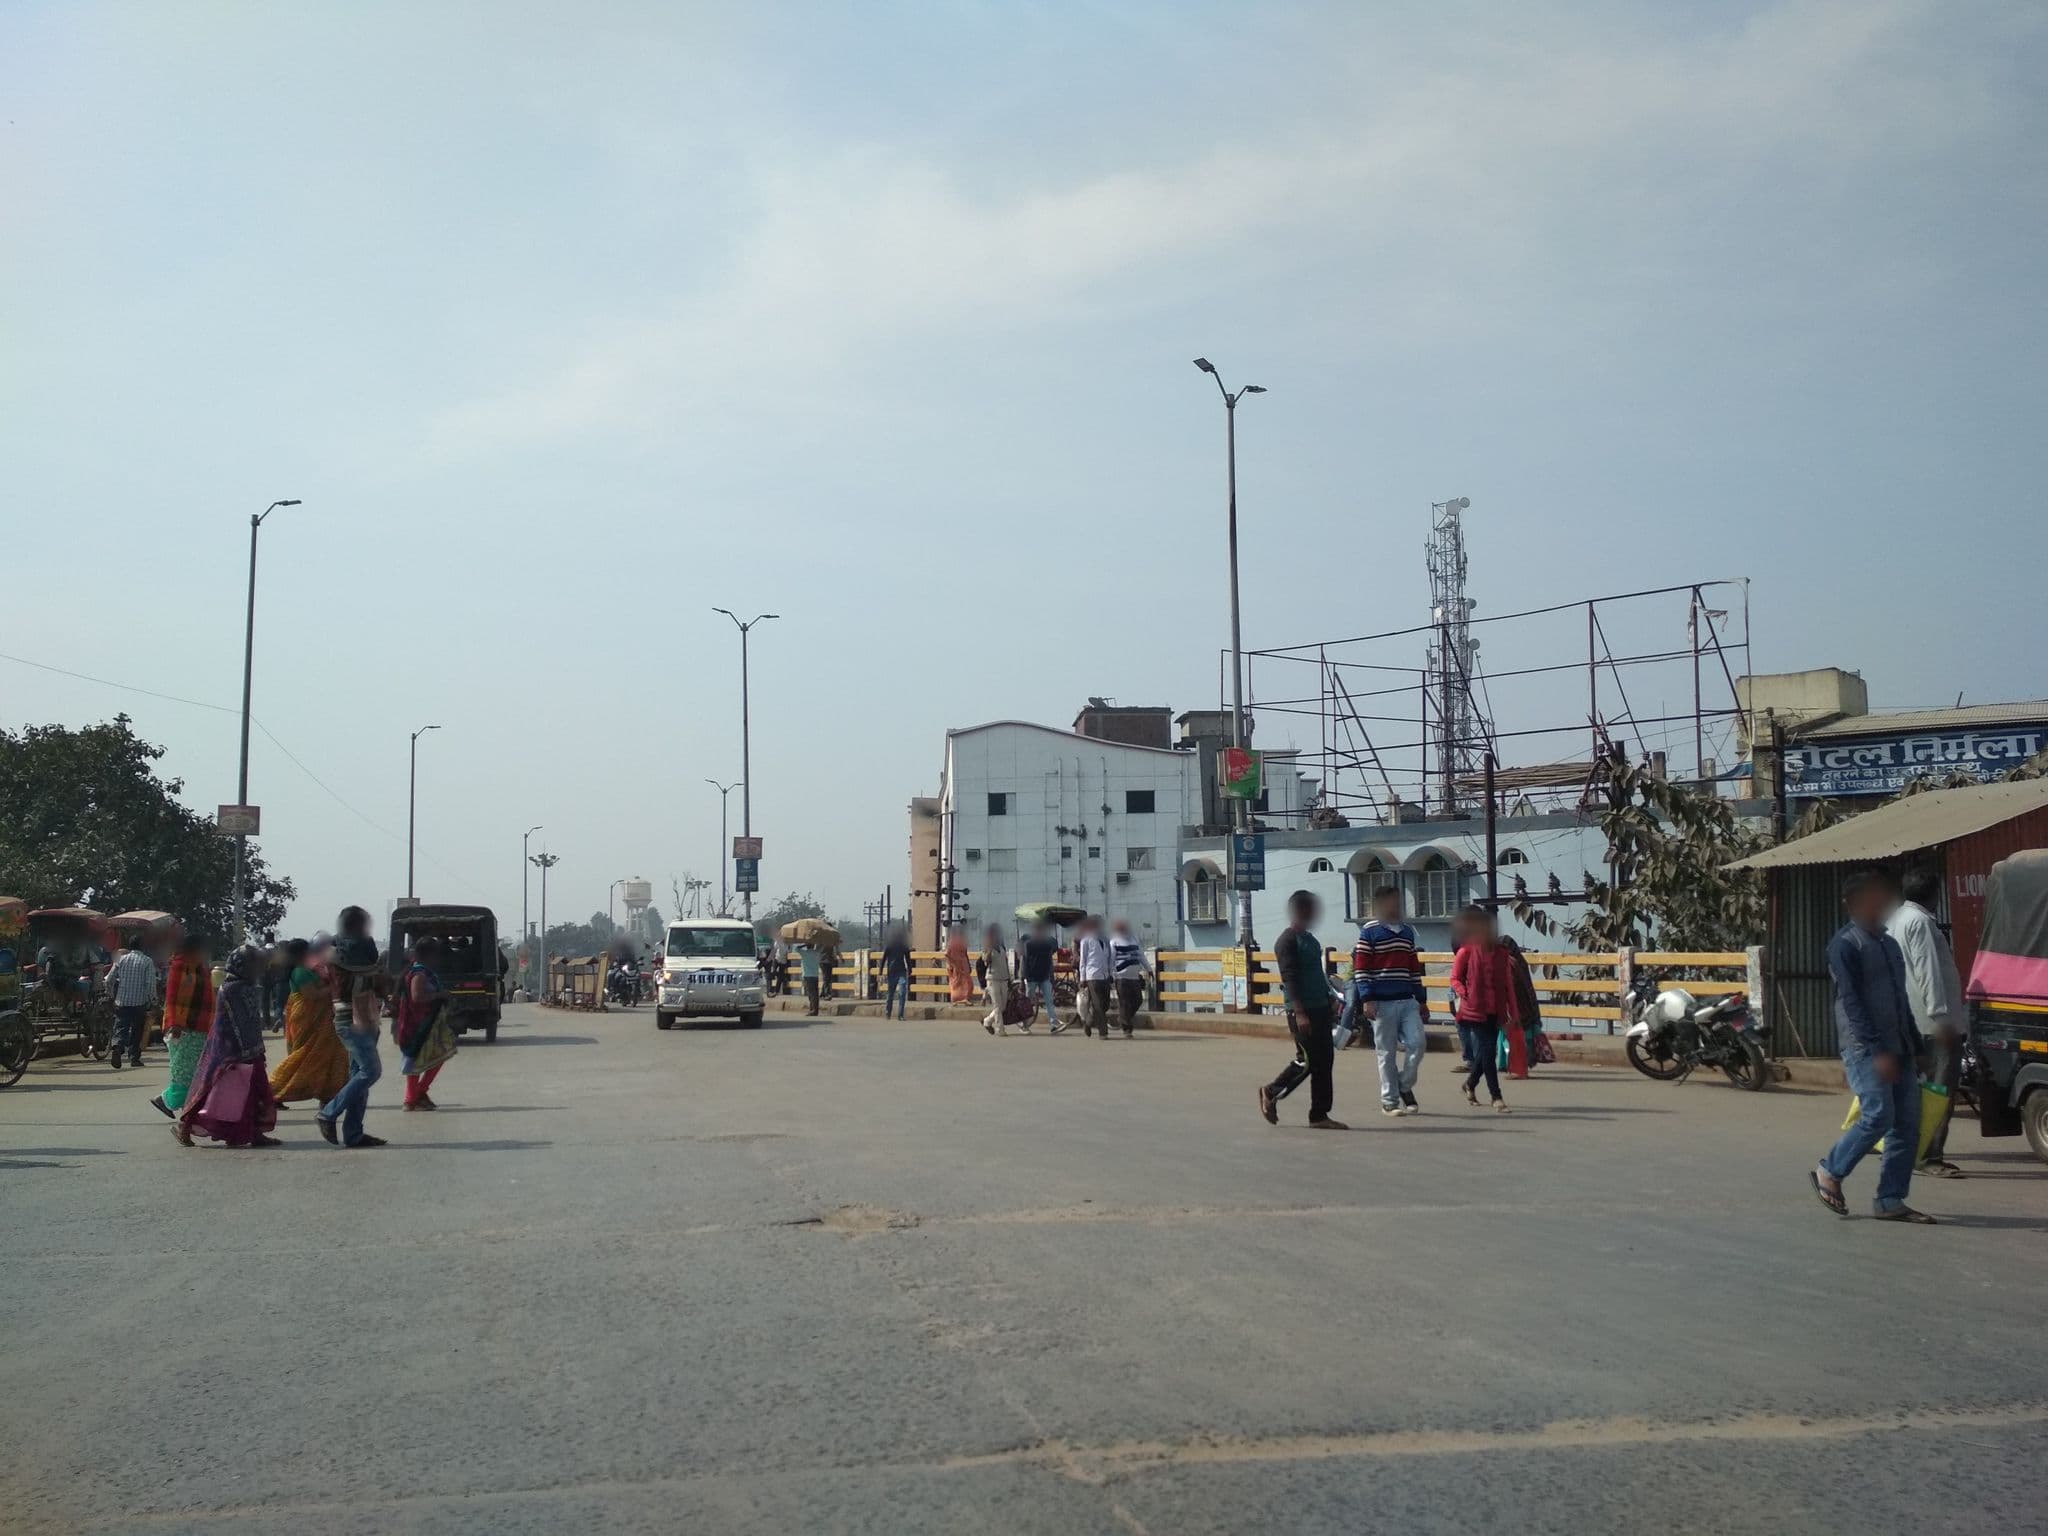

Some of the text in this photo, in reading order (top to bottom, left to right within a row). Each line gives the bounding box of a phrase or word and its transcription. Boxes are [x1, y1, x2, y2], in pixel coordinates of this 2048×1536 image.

[1899, 734, 2041, 763] निर्मला
[1862, 766, 1884, 778] का
[1955, 874, 1992, 897] LION
